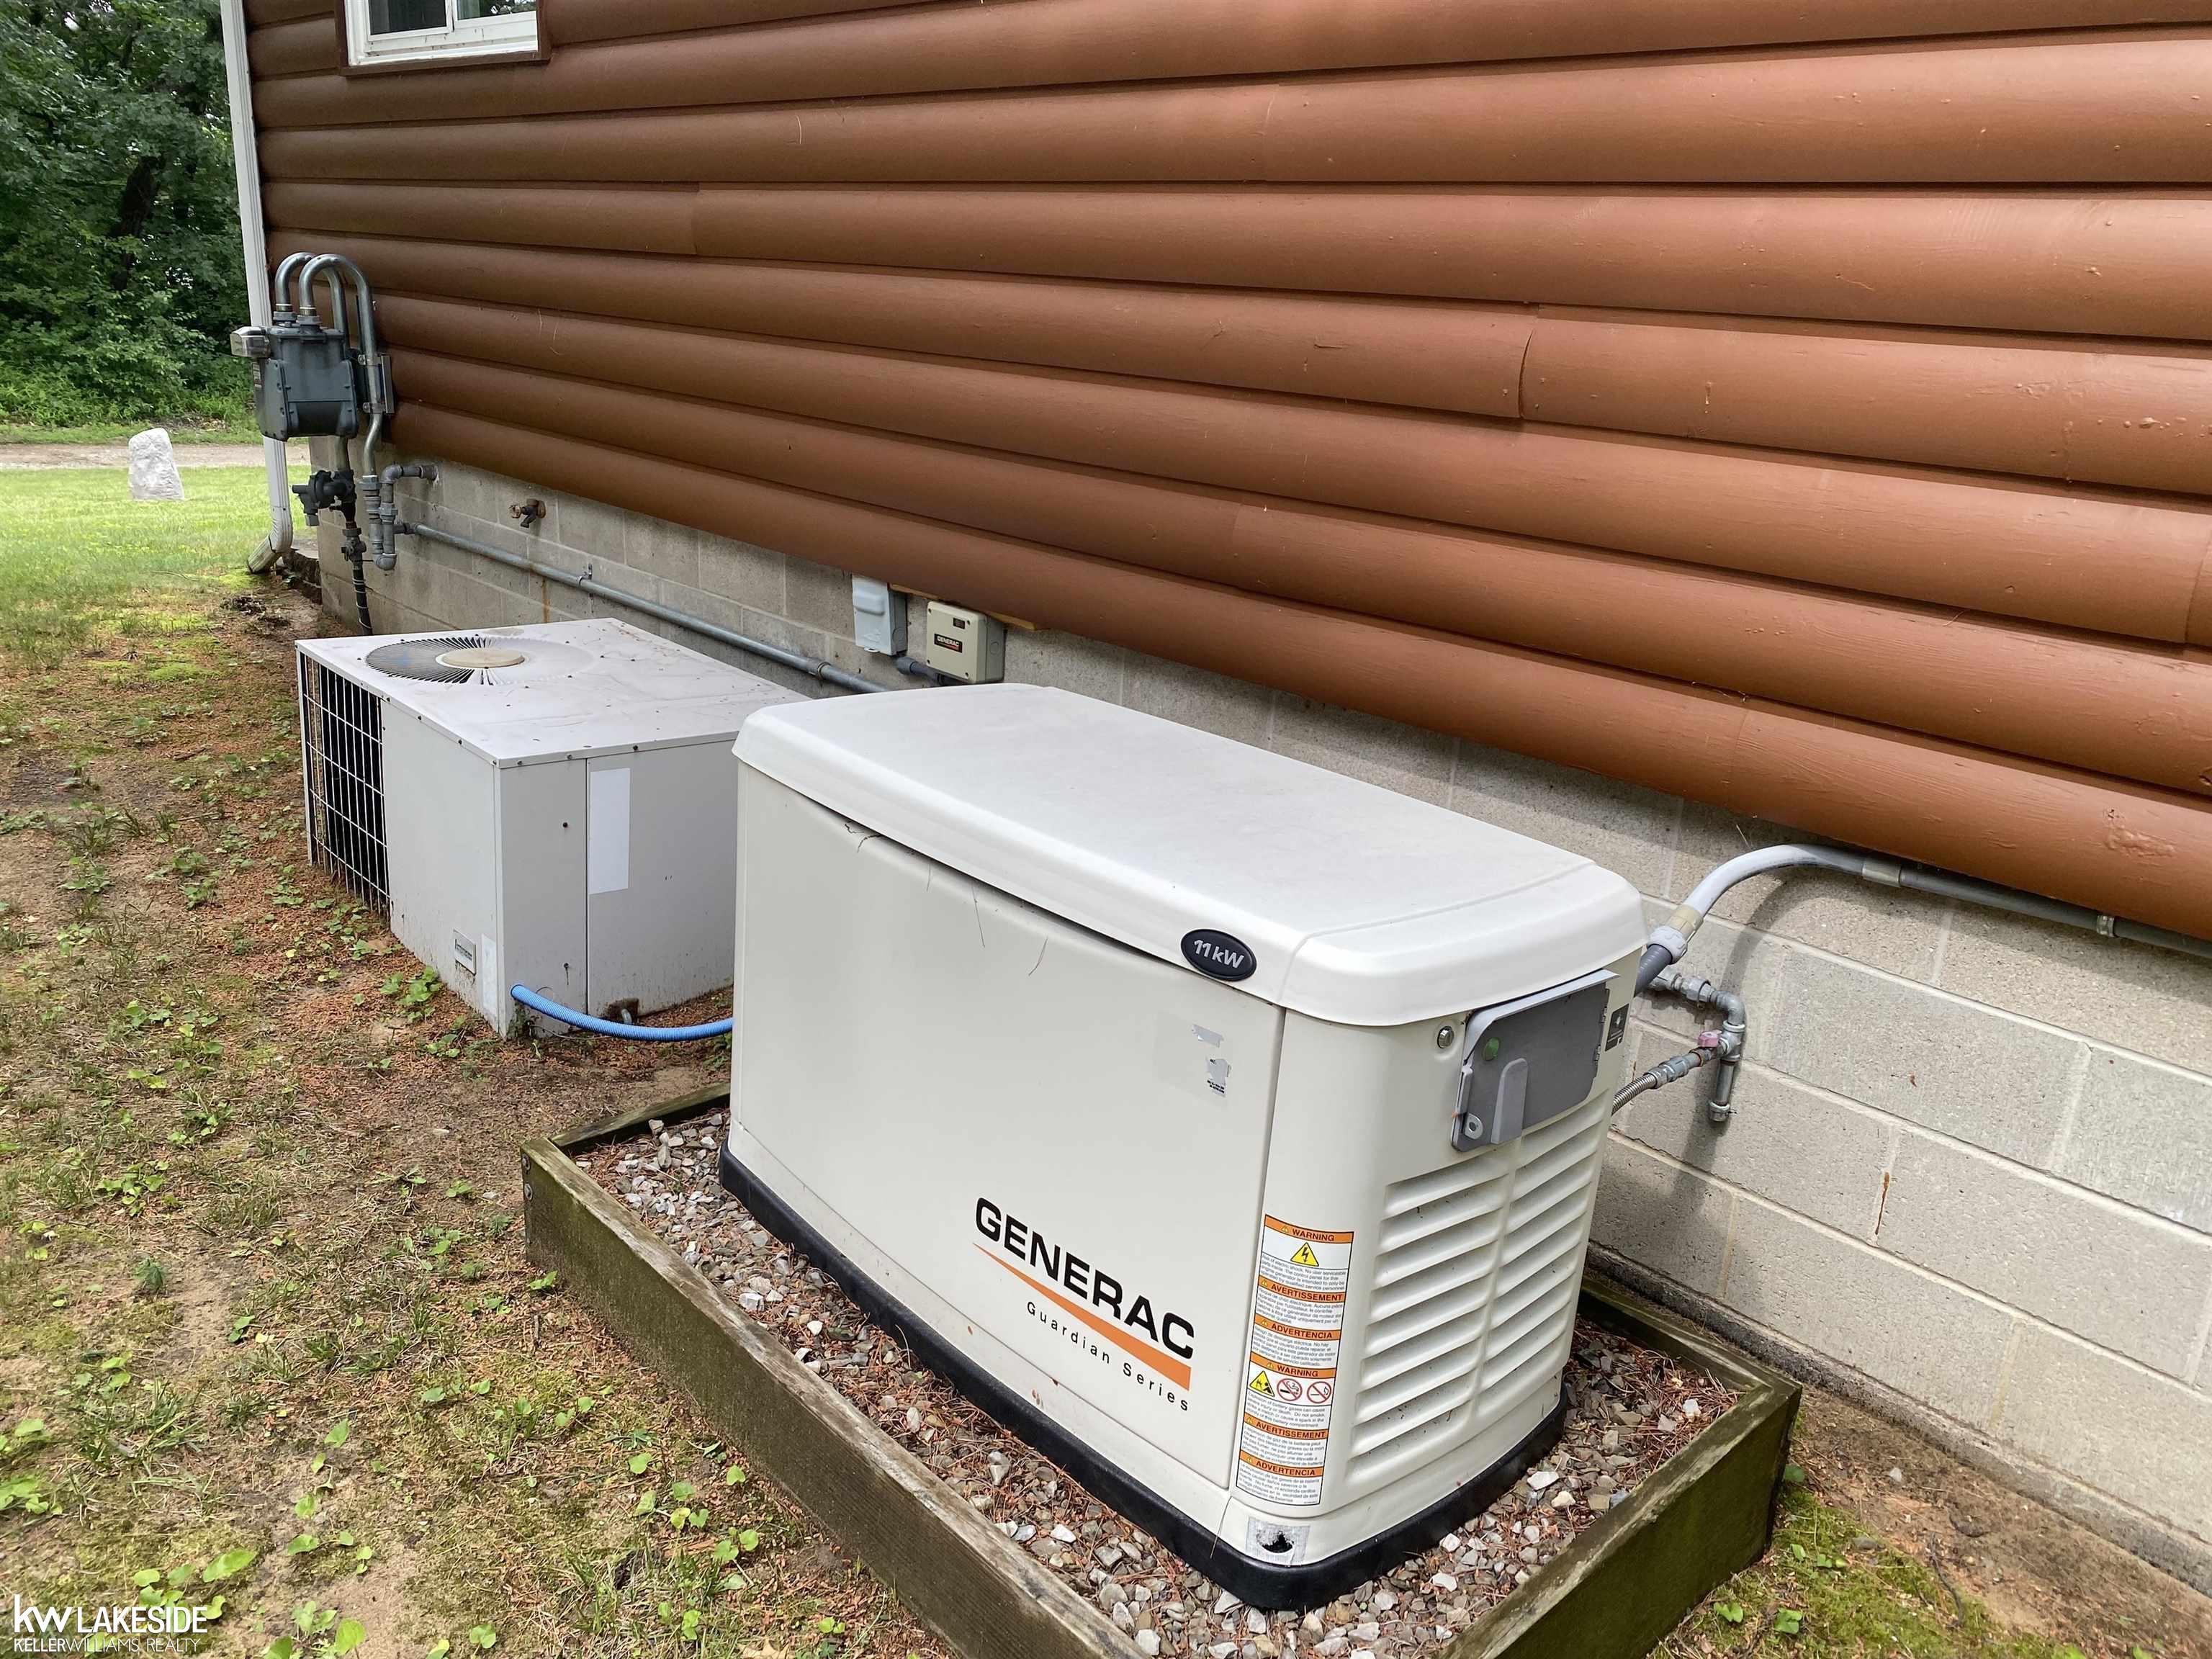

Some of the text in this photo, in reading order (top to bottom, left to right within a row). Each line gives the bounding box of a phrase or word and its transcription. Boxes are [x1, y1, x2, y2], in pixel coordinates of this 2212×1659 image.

[1292, 1228, 1334, 1241] WARNING
[976, 1197, 1195, 1359] GENERAC
[1271, 1284, 1343, 1301] AVERTISSEMENT
[1272, 1323, 1333, 1339] ADVERTENCIA
[1027, 1301, 1188, 1411] Guardian Series
[1277, 1365, 1318, 1377] WARNING
[1256, 1421, 1326, 1439] AVERTISSEMENT
[1256, 1461, 1316, 1476] ADVERTENCIA
